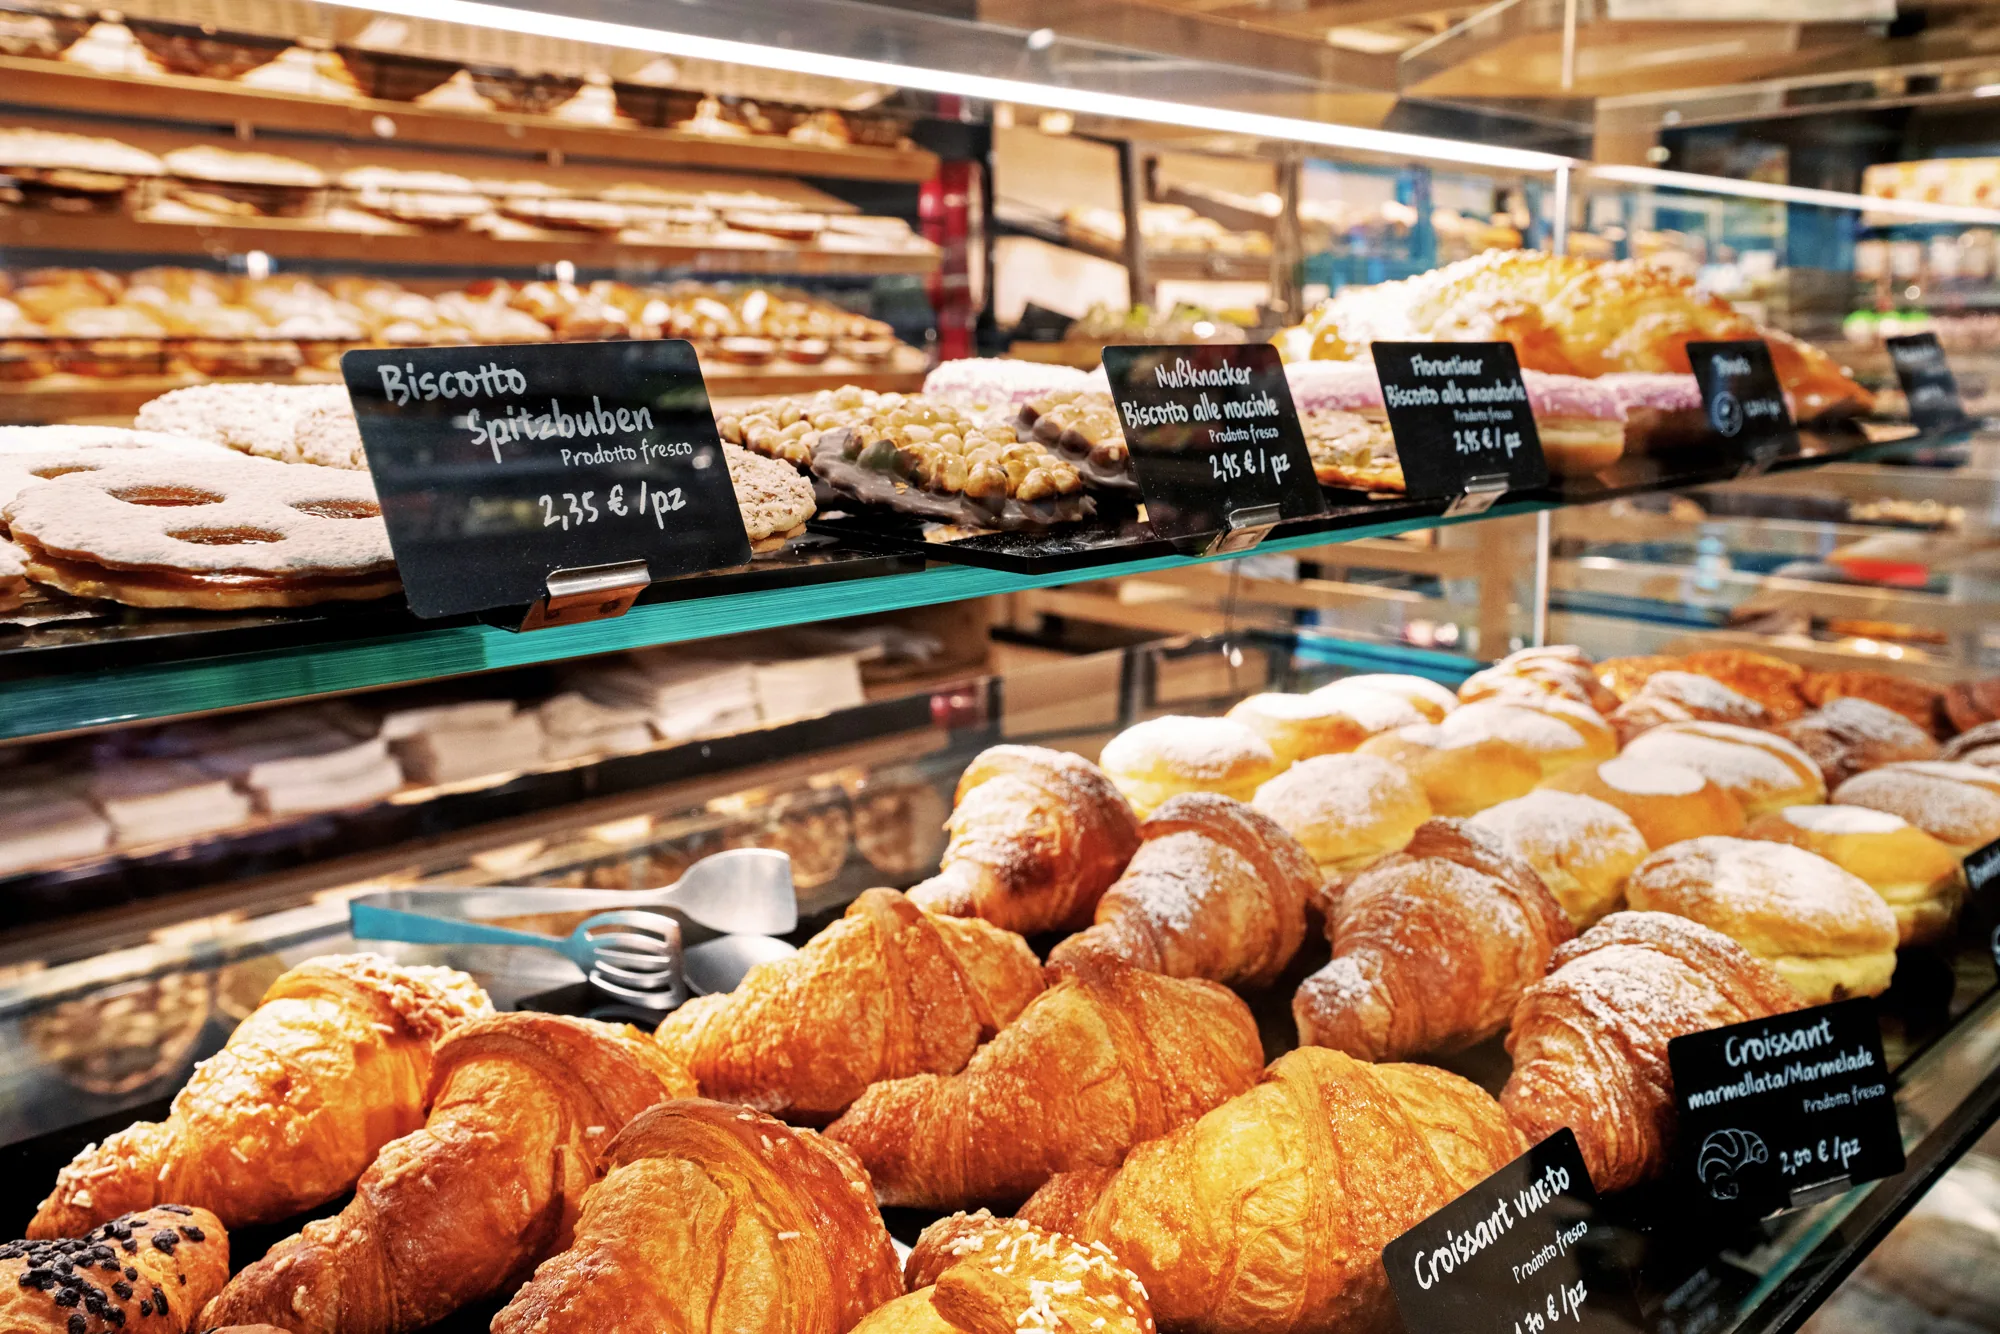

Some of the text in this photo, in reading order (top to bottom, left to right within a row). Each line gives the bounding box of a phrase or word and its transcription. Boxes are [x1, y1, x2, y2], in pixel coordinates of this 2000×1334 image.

[1154, 357, 1251, 388] Nußknacker
[1410, 353, 1483, 376] Florentiner
[377, 362, 527, 407] Biscotto
[1385, 379, 1526, 408] Biscotto alle mandorle
[1121, 390, 1279, 429] Biscotto alle nocciole
[465, 394, 655, 464] Spitzbuben
[1208, 424, 1278, 444] Prodotto fresco
[561, 438, 694, 468] Prodotto fresco
[1209, 453, 1241, 482] 2,95
[1244, 450, 1256, 474] €
[538, 491, 598, 530] 2,35
[607, 484, 628, 516] €
[1724, 1016, 1835, 1068] Croissant
[1688, 1045, 1875, 1111] marmellata/Marmelade
[1803, 1084, 1885, 1113] Prodotto fresco
[1780, 1148, 1811, 1175] 2,00
[1818, 1140, 1829, 1162] €
[1414, 1197, 1514, 1289] Croissant
[1556, 1221, 1587, 1257] fresco
